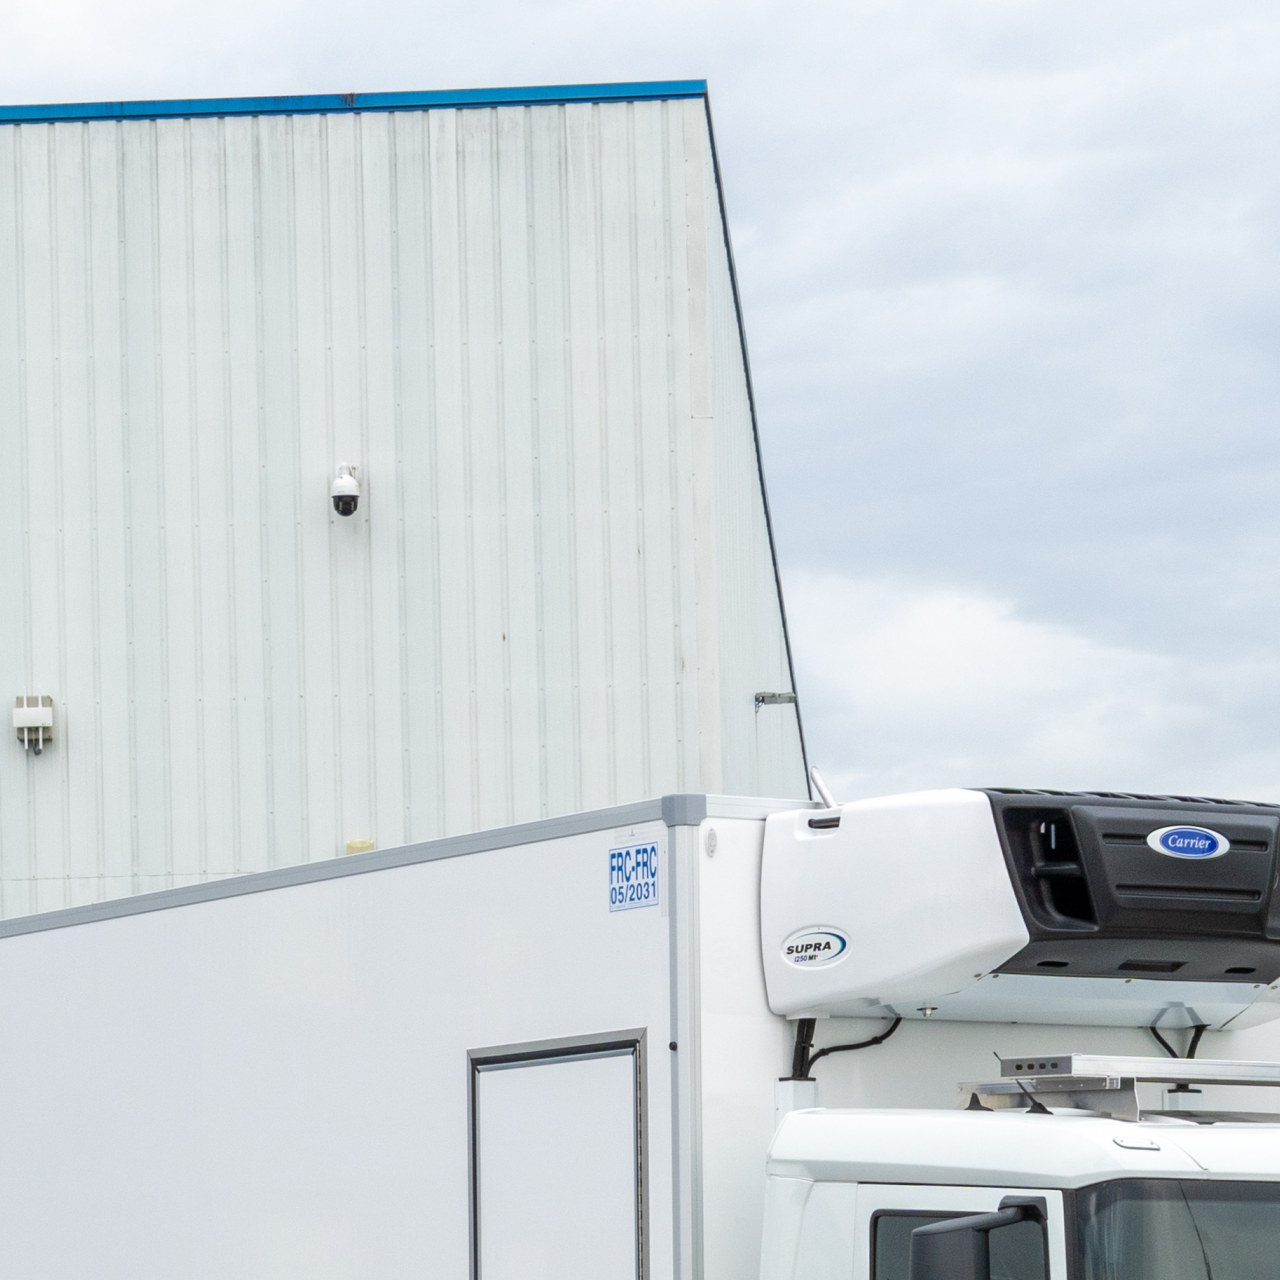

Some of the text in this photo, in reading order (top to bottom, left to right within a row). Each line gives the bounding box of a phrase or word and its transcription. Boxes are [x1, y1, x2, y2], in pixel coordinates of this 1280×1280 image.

[1168, 834, 1211, 849] Carrier
[610, 845, 657, 885] FRC-FRC
[610, 880, 656, 905] 05/2031
[786, 941, 831, 955] SUPRA
